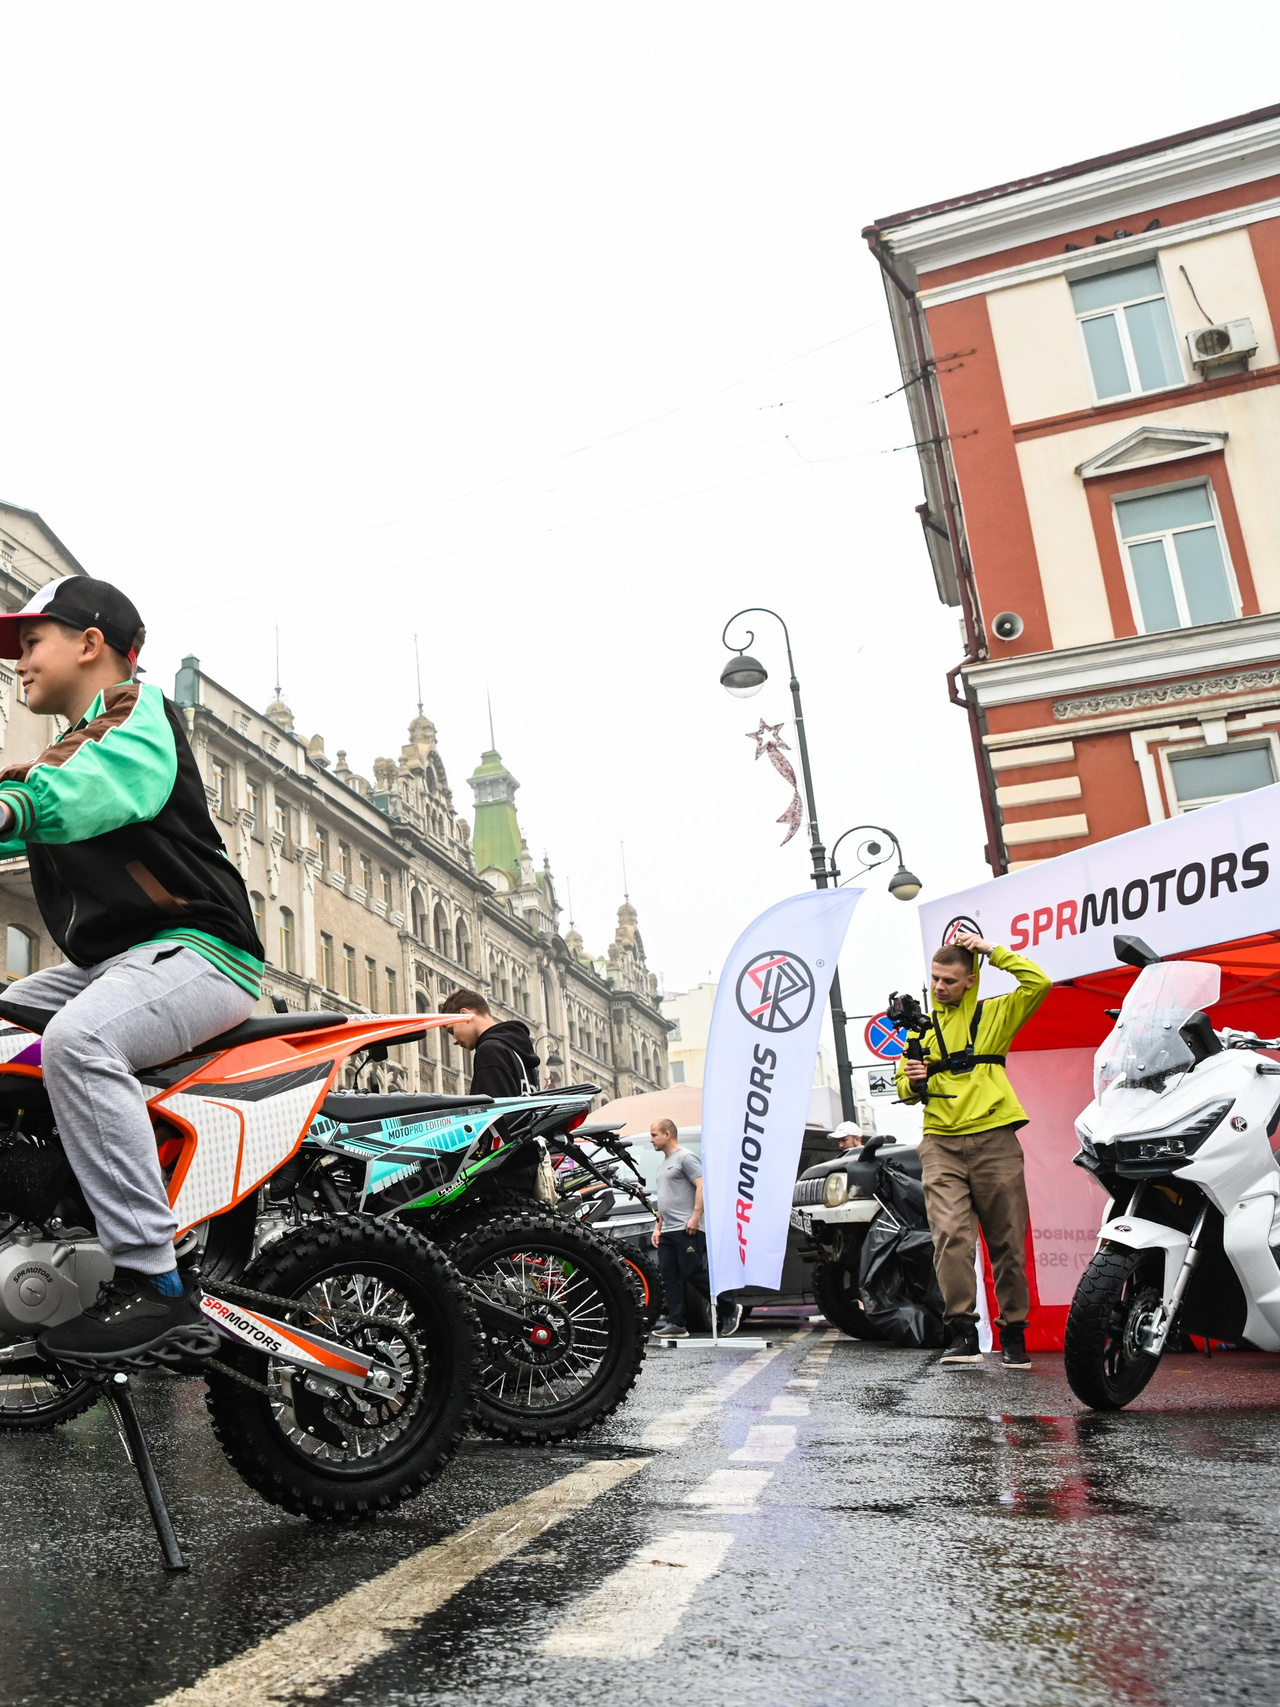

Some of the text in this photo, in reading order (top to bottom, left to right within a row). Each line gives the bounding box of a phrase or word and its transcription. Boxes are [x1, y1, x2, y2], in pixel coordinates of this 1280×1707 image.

[1010, 842, 1269, 951] SPRMOTORS
[388, 1118, 452, 1140] MOTOPRO EDITION
[13, 1266, 54, 1284] SPRMOTORS
[203, 1297, 282, 1352] SPRMOTORS
